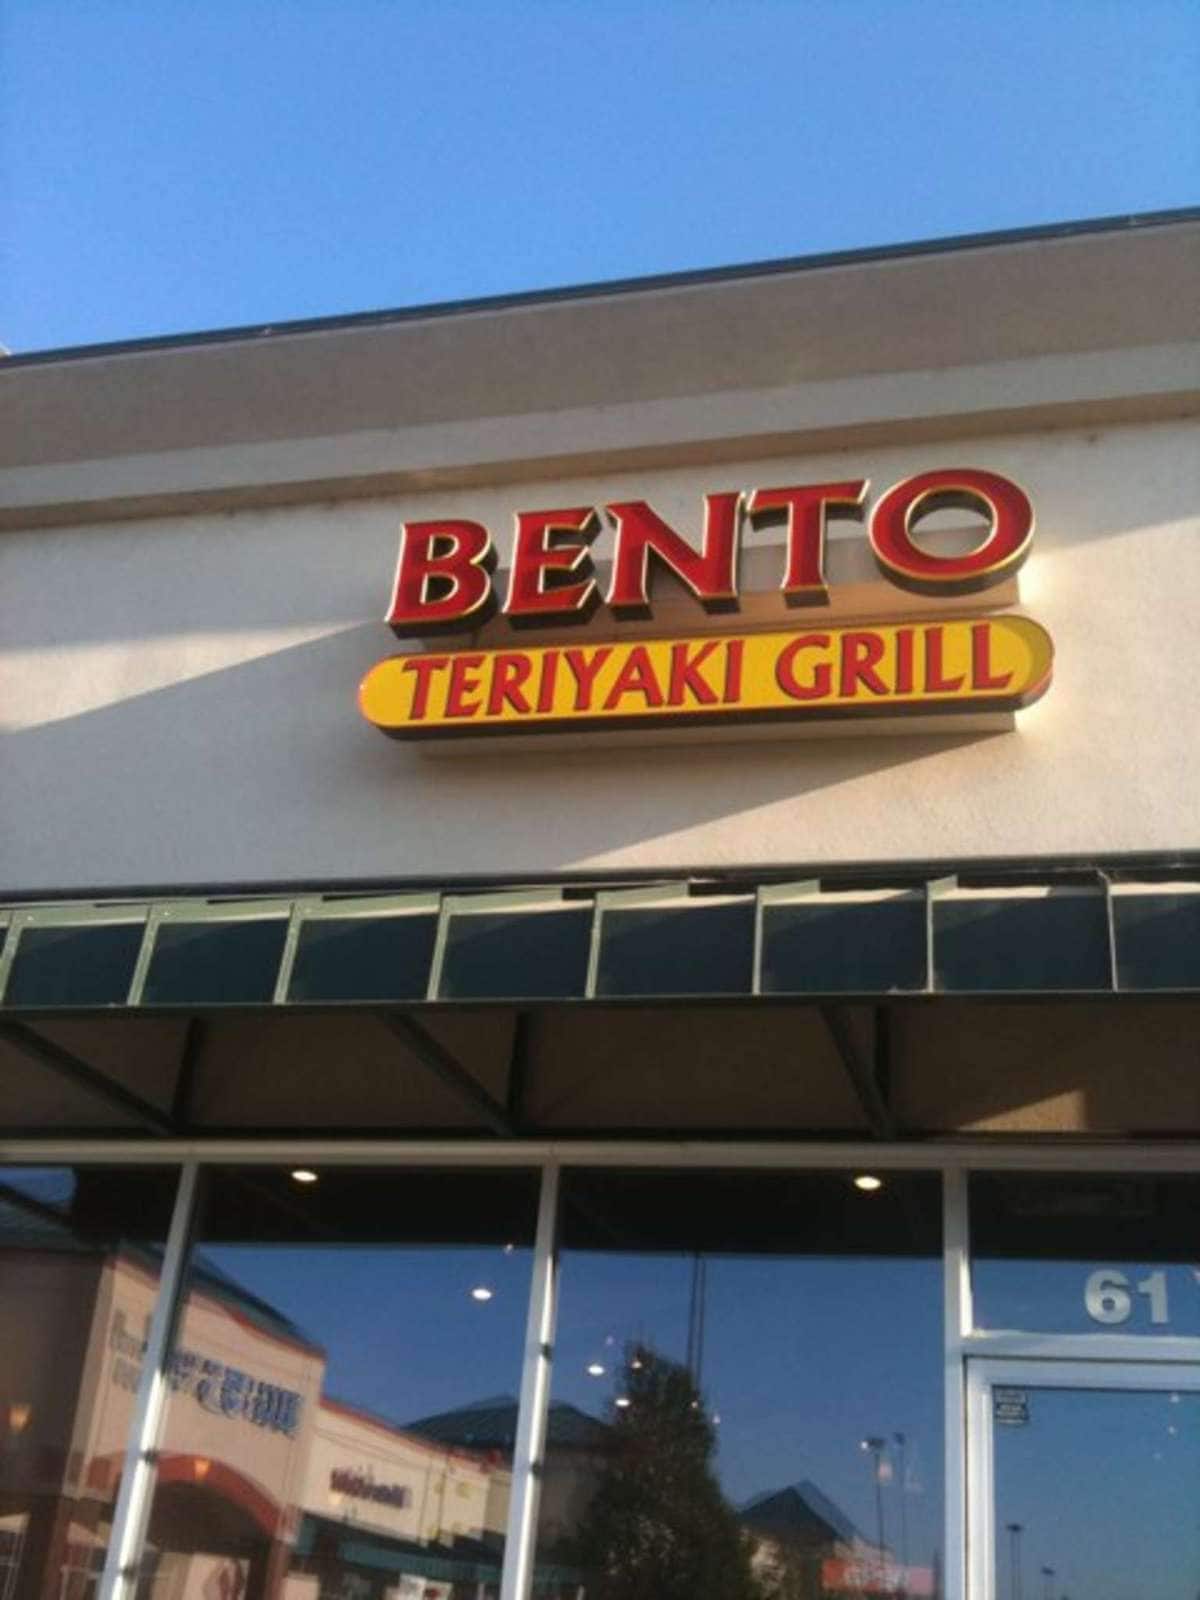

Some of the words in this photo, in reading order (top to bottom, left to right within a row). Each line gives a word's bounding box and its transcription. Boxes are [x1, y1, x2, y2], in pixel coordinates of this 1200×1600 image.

[386, 468, 1035, 626] BENTO
[403, 640, 744, 721] TERIYAKI
[776, 623, 1014, 702] GRILL
[1085, 1270, 1168, 1325] 61
